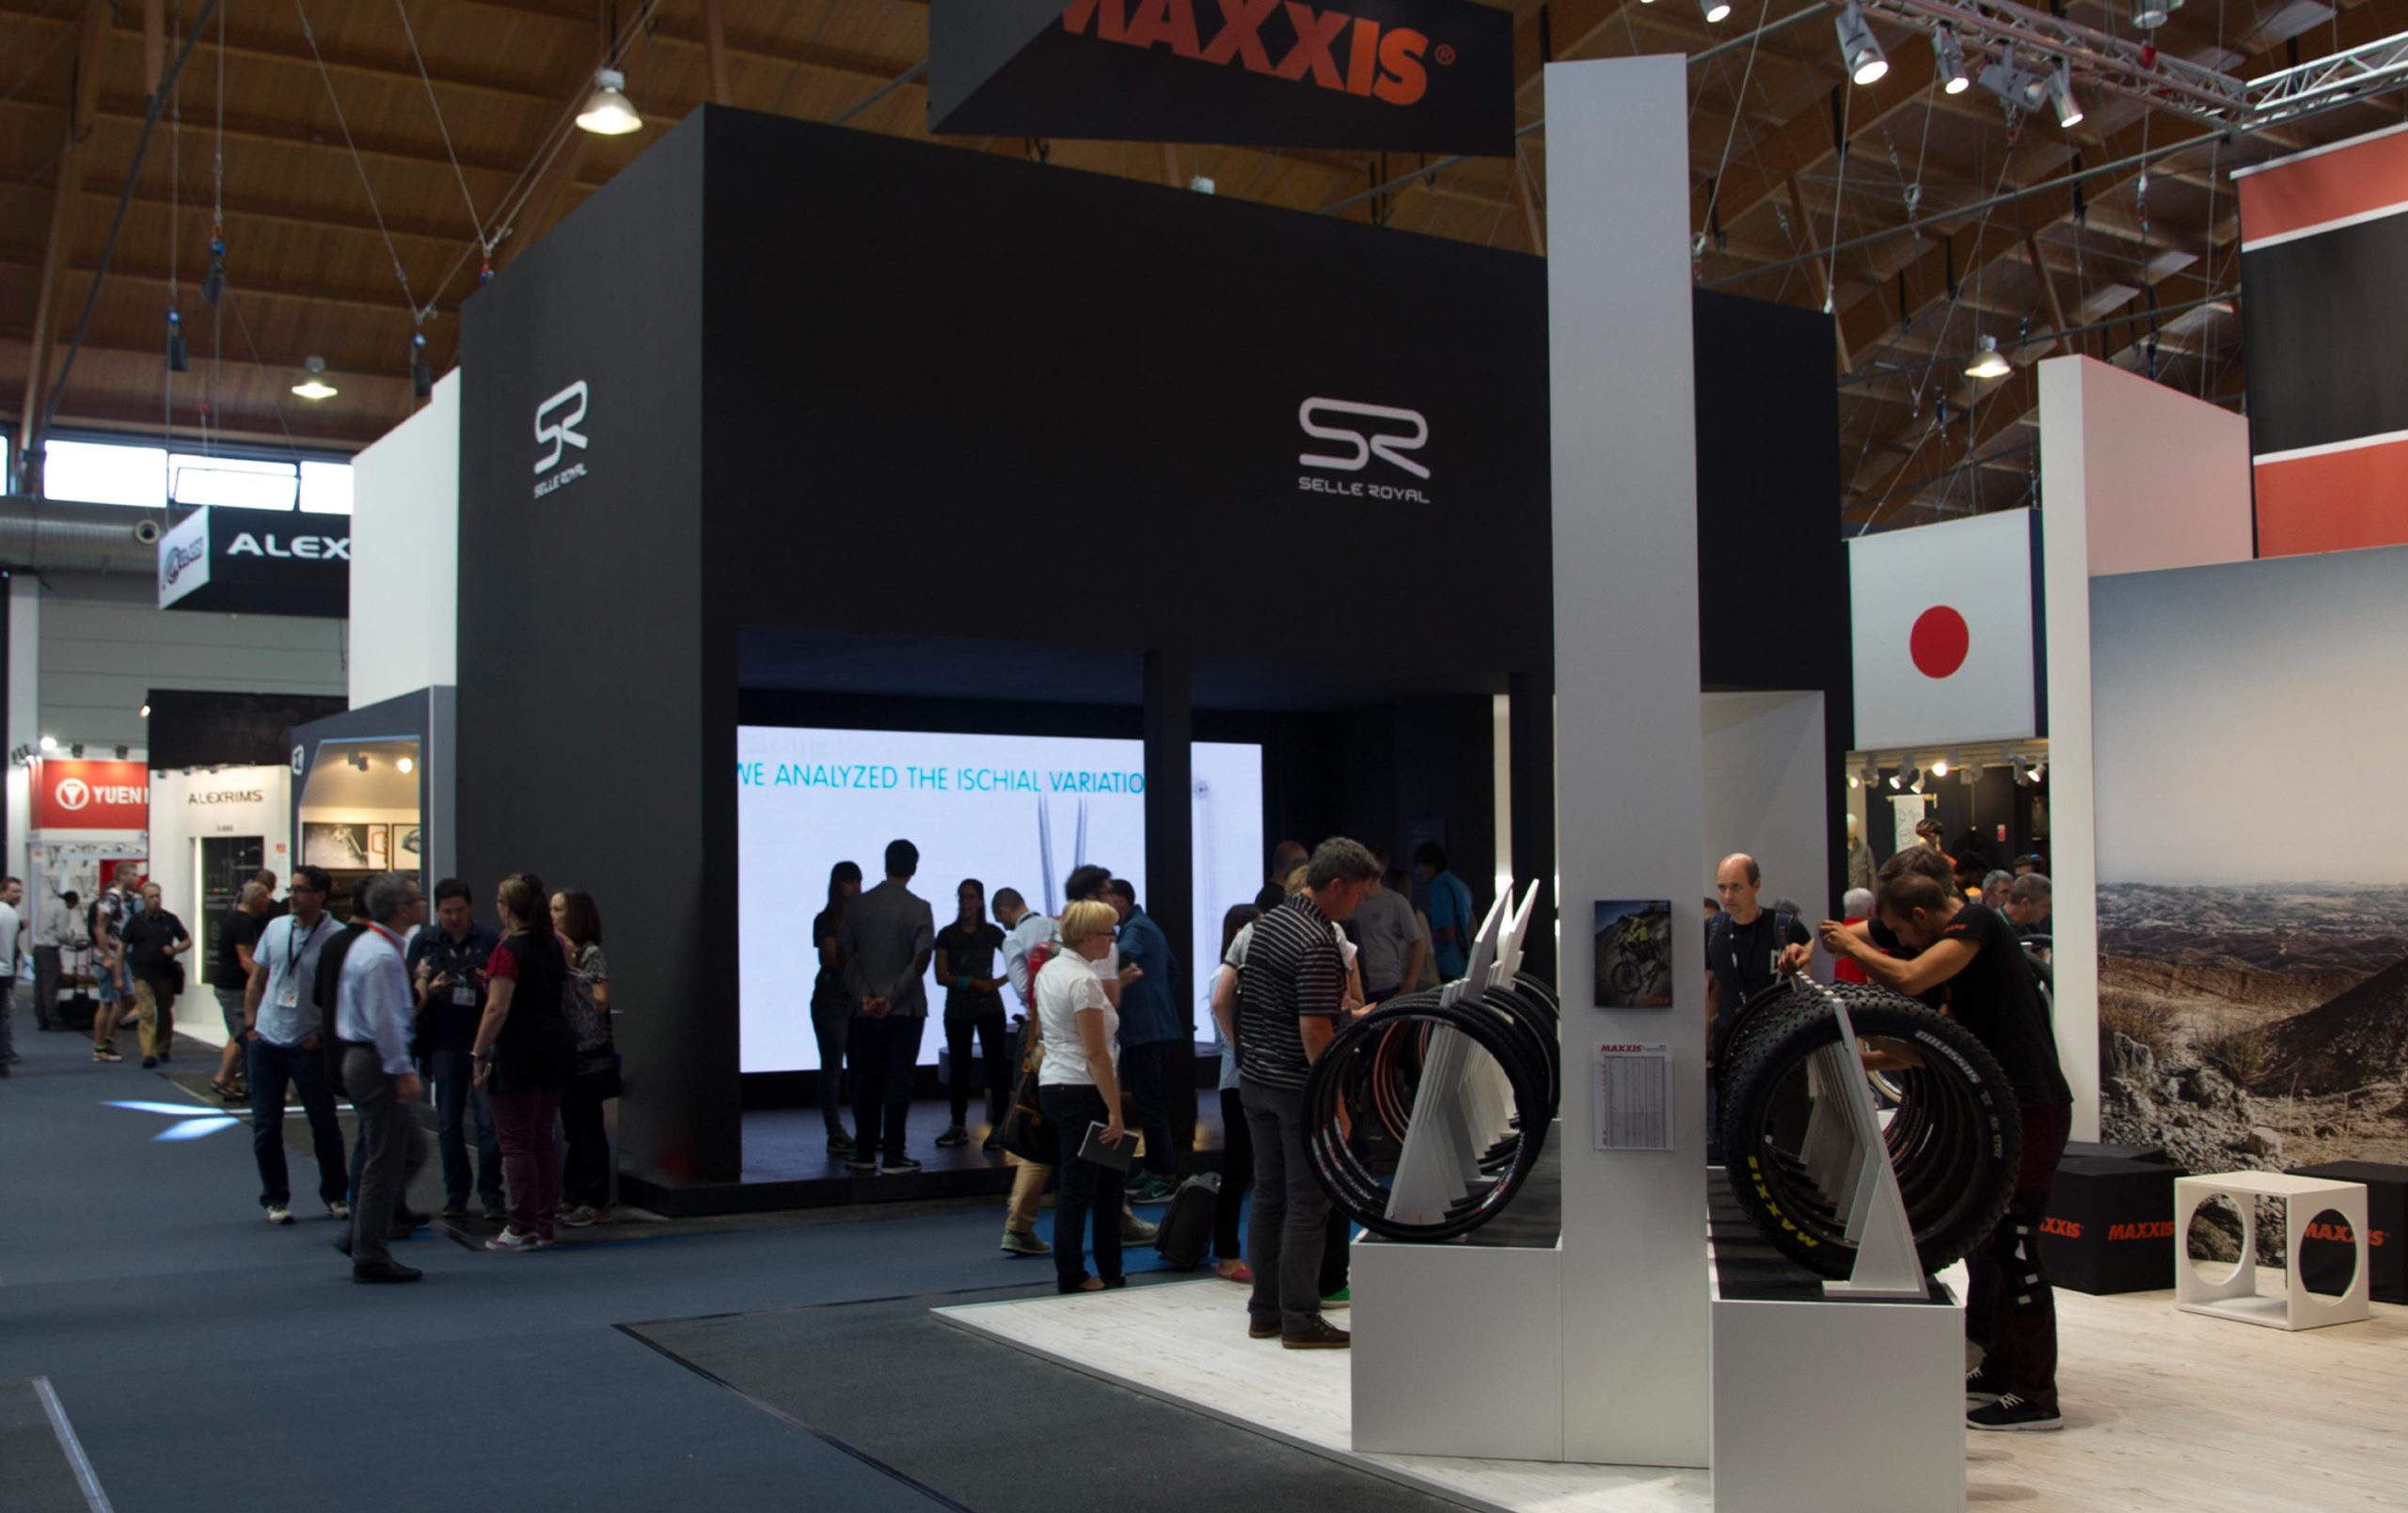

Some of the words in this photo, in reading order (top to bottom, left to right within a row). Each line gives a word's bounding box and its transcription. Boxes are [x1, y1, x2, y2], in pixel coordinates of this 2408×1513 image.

[533, 474, 561, 499] SELLE
[1298, 476, 1364, 497] SELLE
[1367, 484, 1432, 505] ROYAL
[775, 764, 898, 790] ANALYZED
[909, 766, 950, 791] THE
[958, 768, 1041, 793] ISCHIAL
[188, 789, 263, 806] ALEXRIMS
[1600, 1044, 1642, 1053] MAXXIS
[1747, 1154, 1819, 1249] MAXXIS
[2107, 1221, 2175, 1241] MAXXIS
